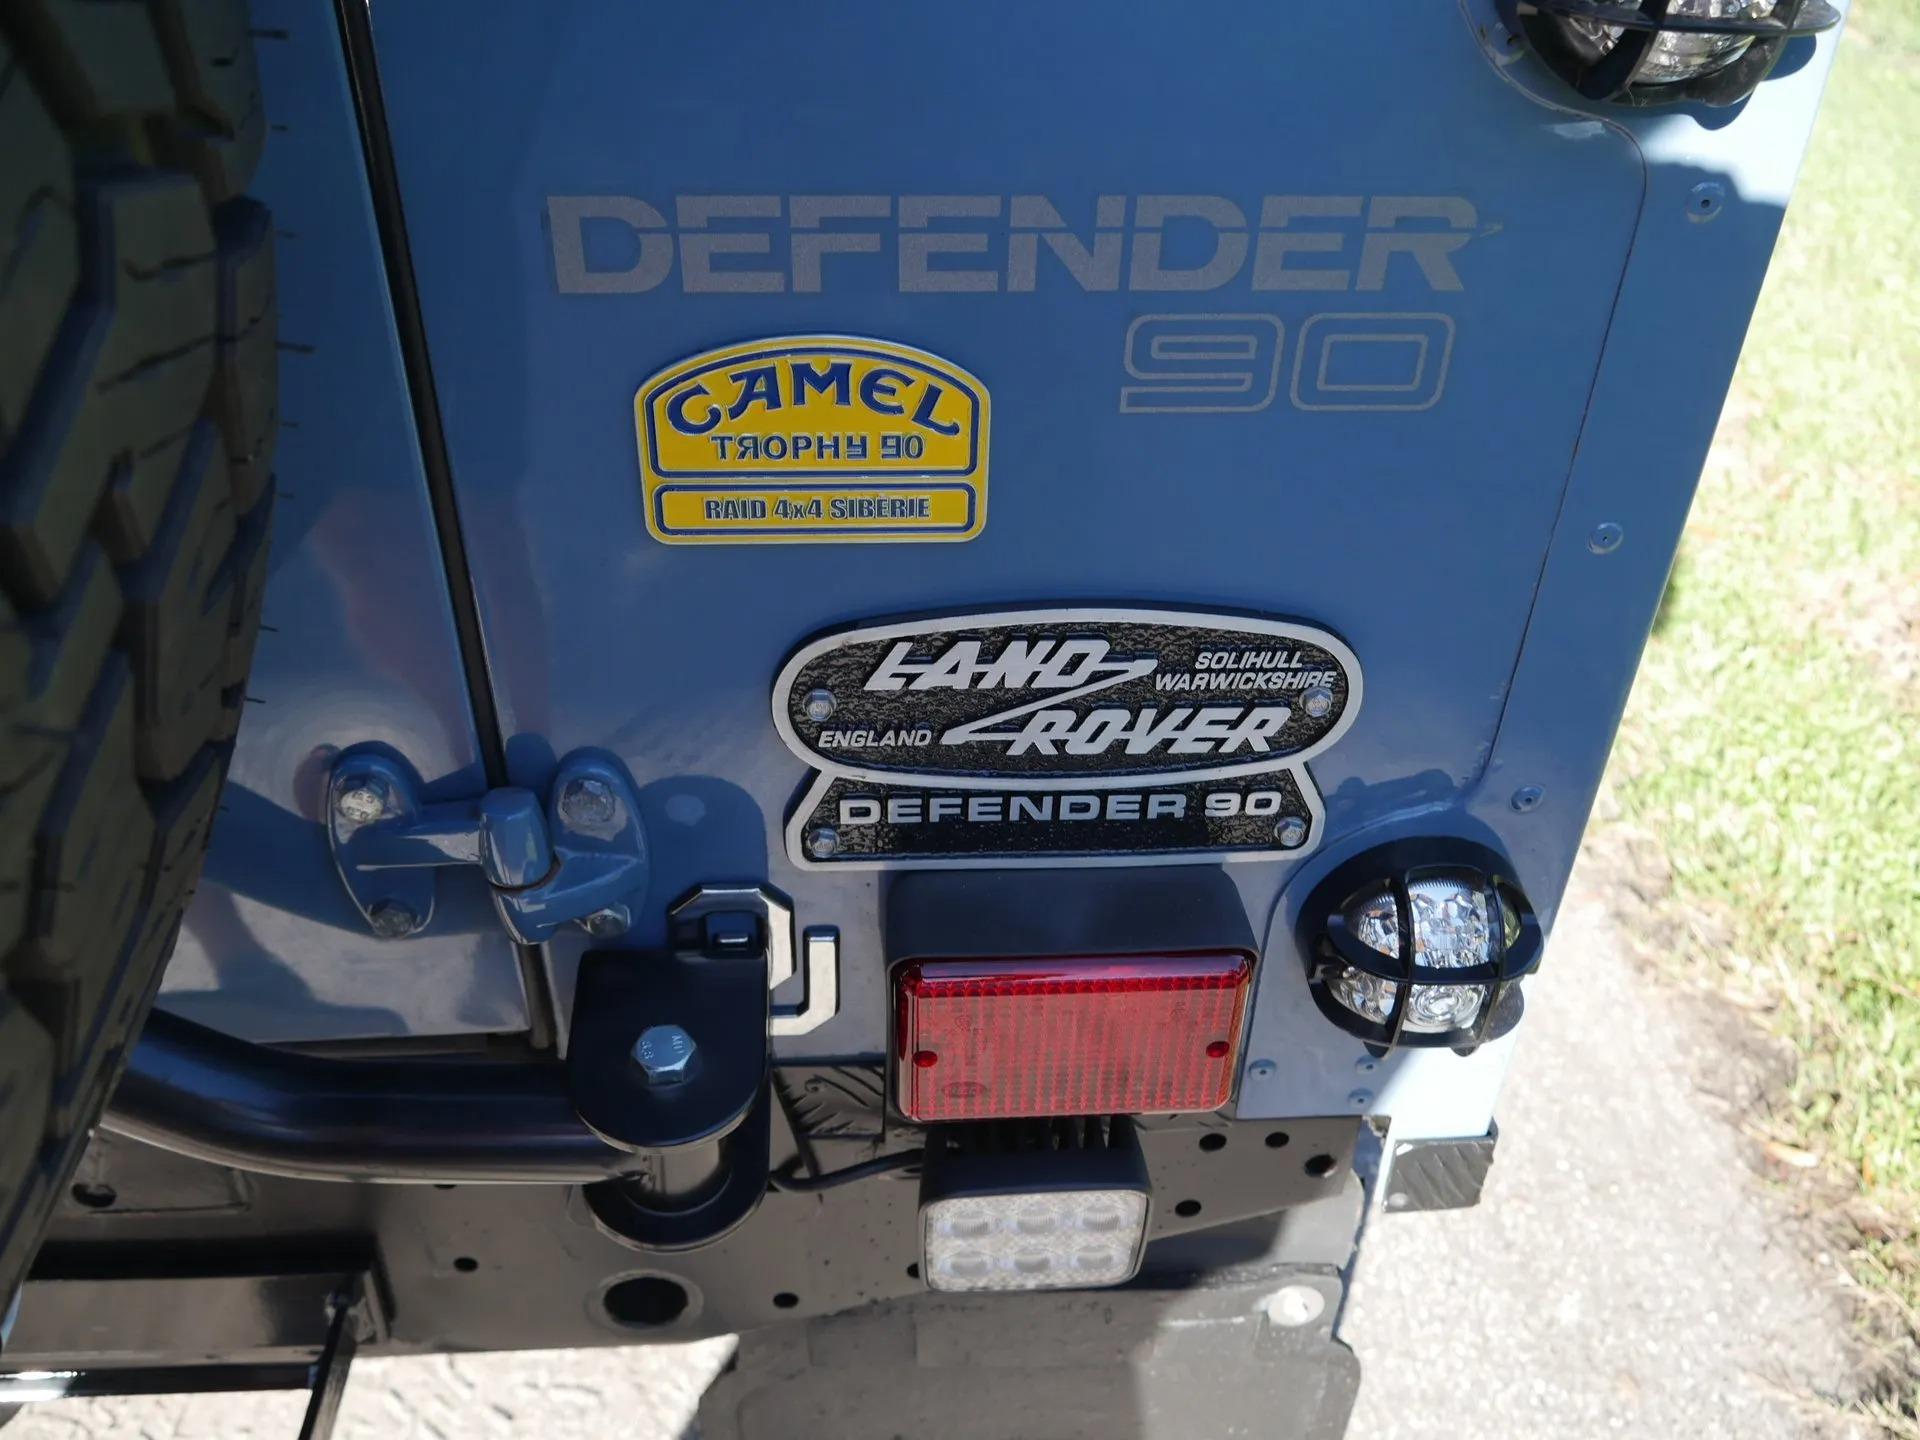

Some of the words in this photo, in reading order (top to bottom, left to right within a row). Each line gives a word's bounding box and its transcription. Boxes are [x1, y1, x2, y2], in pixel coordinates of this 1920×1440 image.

[546, 194, 1479, 295] DEFENDER
[1120, 312, 1456, 414] 90
[665, 358, 961, 437] CAMEL
[703, 496, 767, 521] RAID
[773, 496, 824, 520] 4x4
[864, 638, 1115, 691] LAND
[1155, 670, 1337, 692] WARWICKSHIRE
[1194, 650, 1303, 671] SOLIHULL
[817, 728, 933, 748] ENGLAND
[1007, 706, 1292, 757] ROVER
[838, 793, 1187, 826] DEFENDER
[1203, 790, 1283, 819] 90
